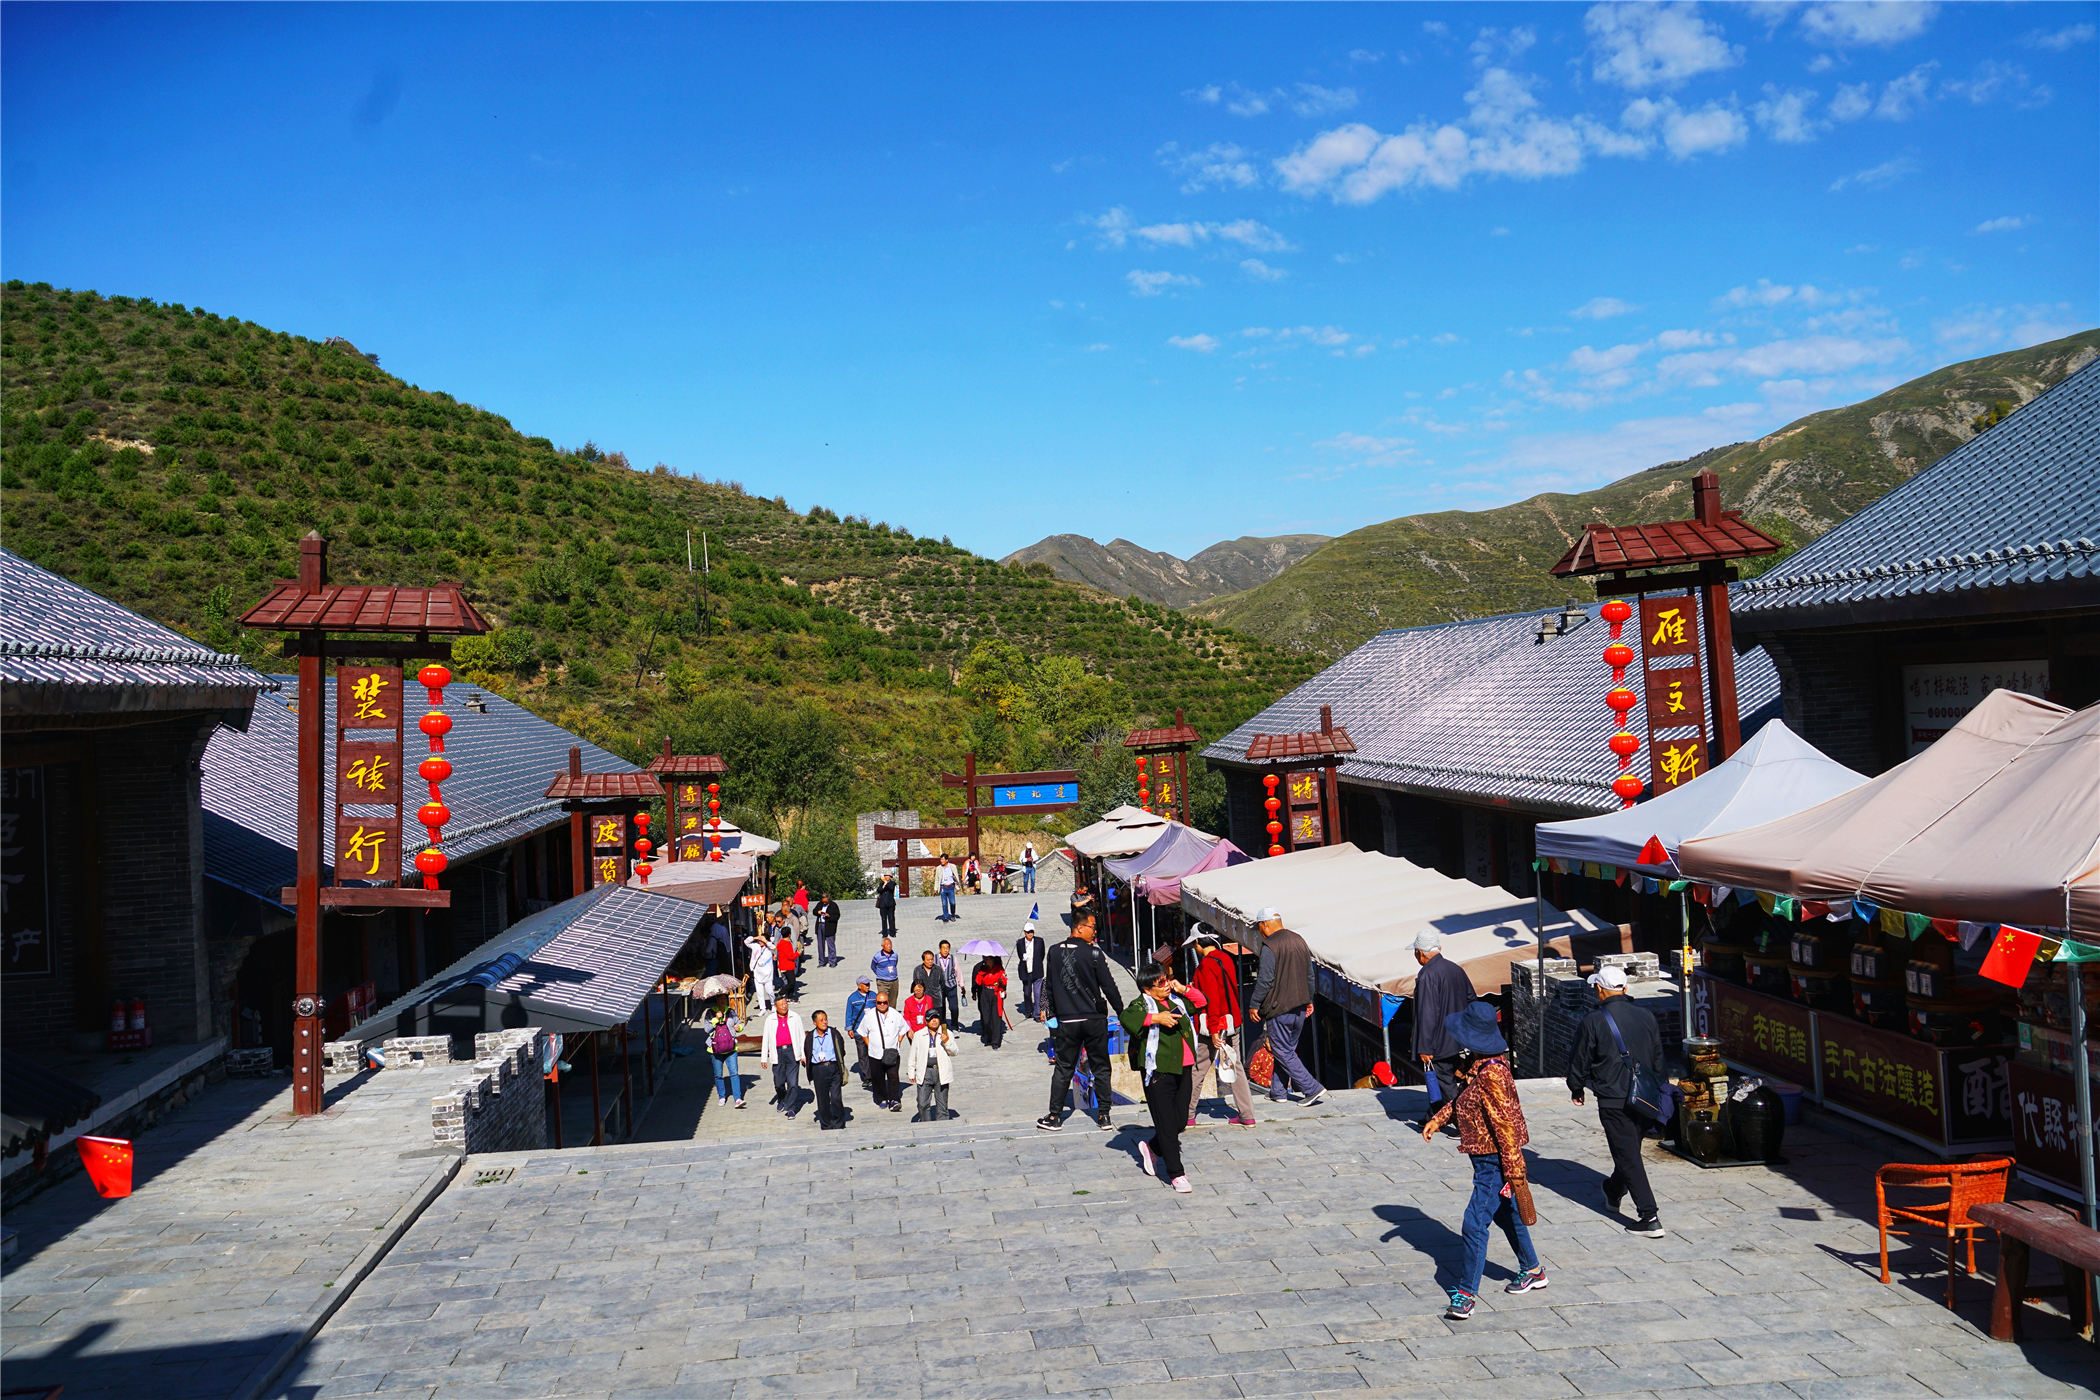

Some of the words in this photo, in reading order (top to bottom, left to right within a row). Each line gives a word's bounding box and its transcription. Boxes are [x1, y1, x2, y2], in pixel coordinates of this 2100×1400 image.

[1, 927, 42, 964] 产
[1752, 1011, 1807, 1065] 老陳醋
